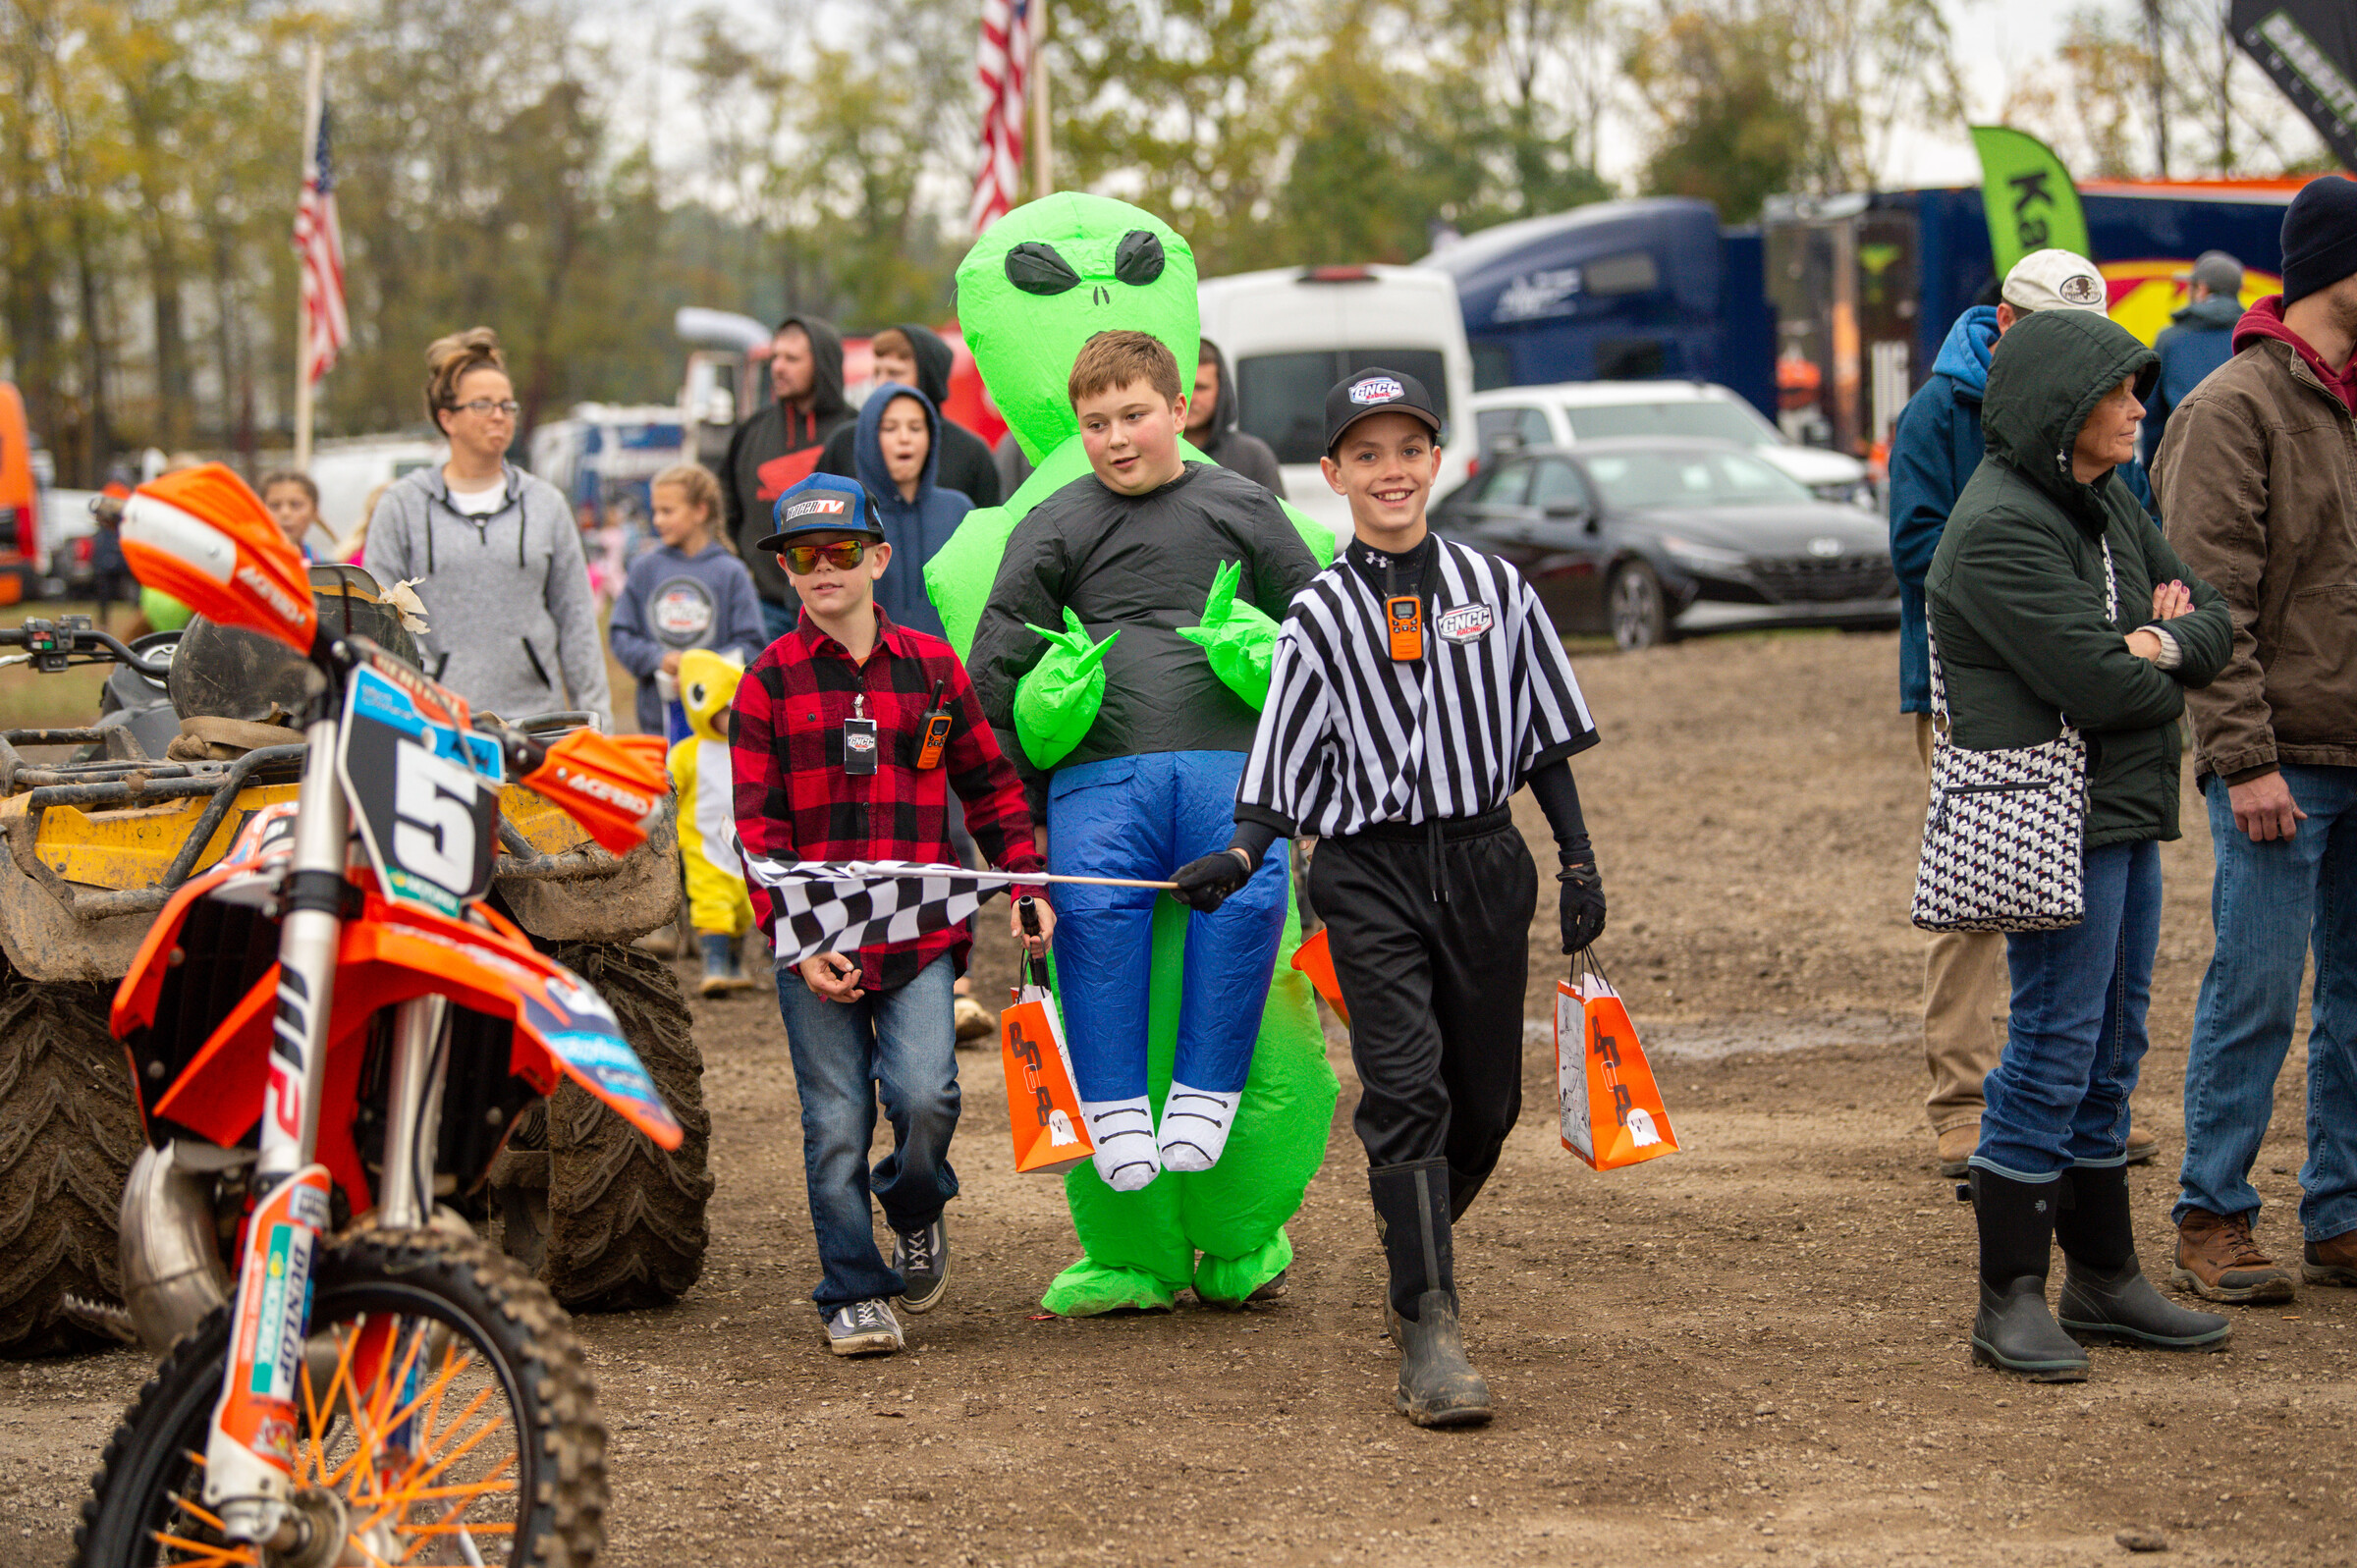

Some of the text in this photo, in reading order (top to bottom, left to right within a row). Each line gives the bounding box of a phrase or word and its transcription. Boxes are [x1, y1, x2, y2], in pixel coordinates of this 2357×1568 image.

[1354, 382, 1399, 397] GNCC
[1442, 608, 1490, 634] GNCC
[1456, 624, 1482, 636] RACING
[849, 735, 874, 746] GNCC
[395, 737, 476, 895] 5
[282, 1247, 307, 1384] DUNLOP
